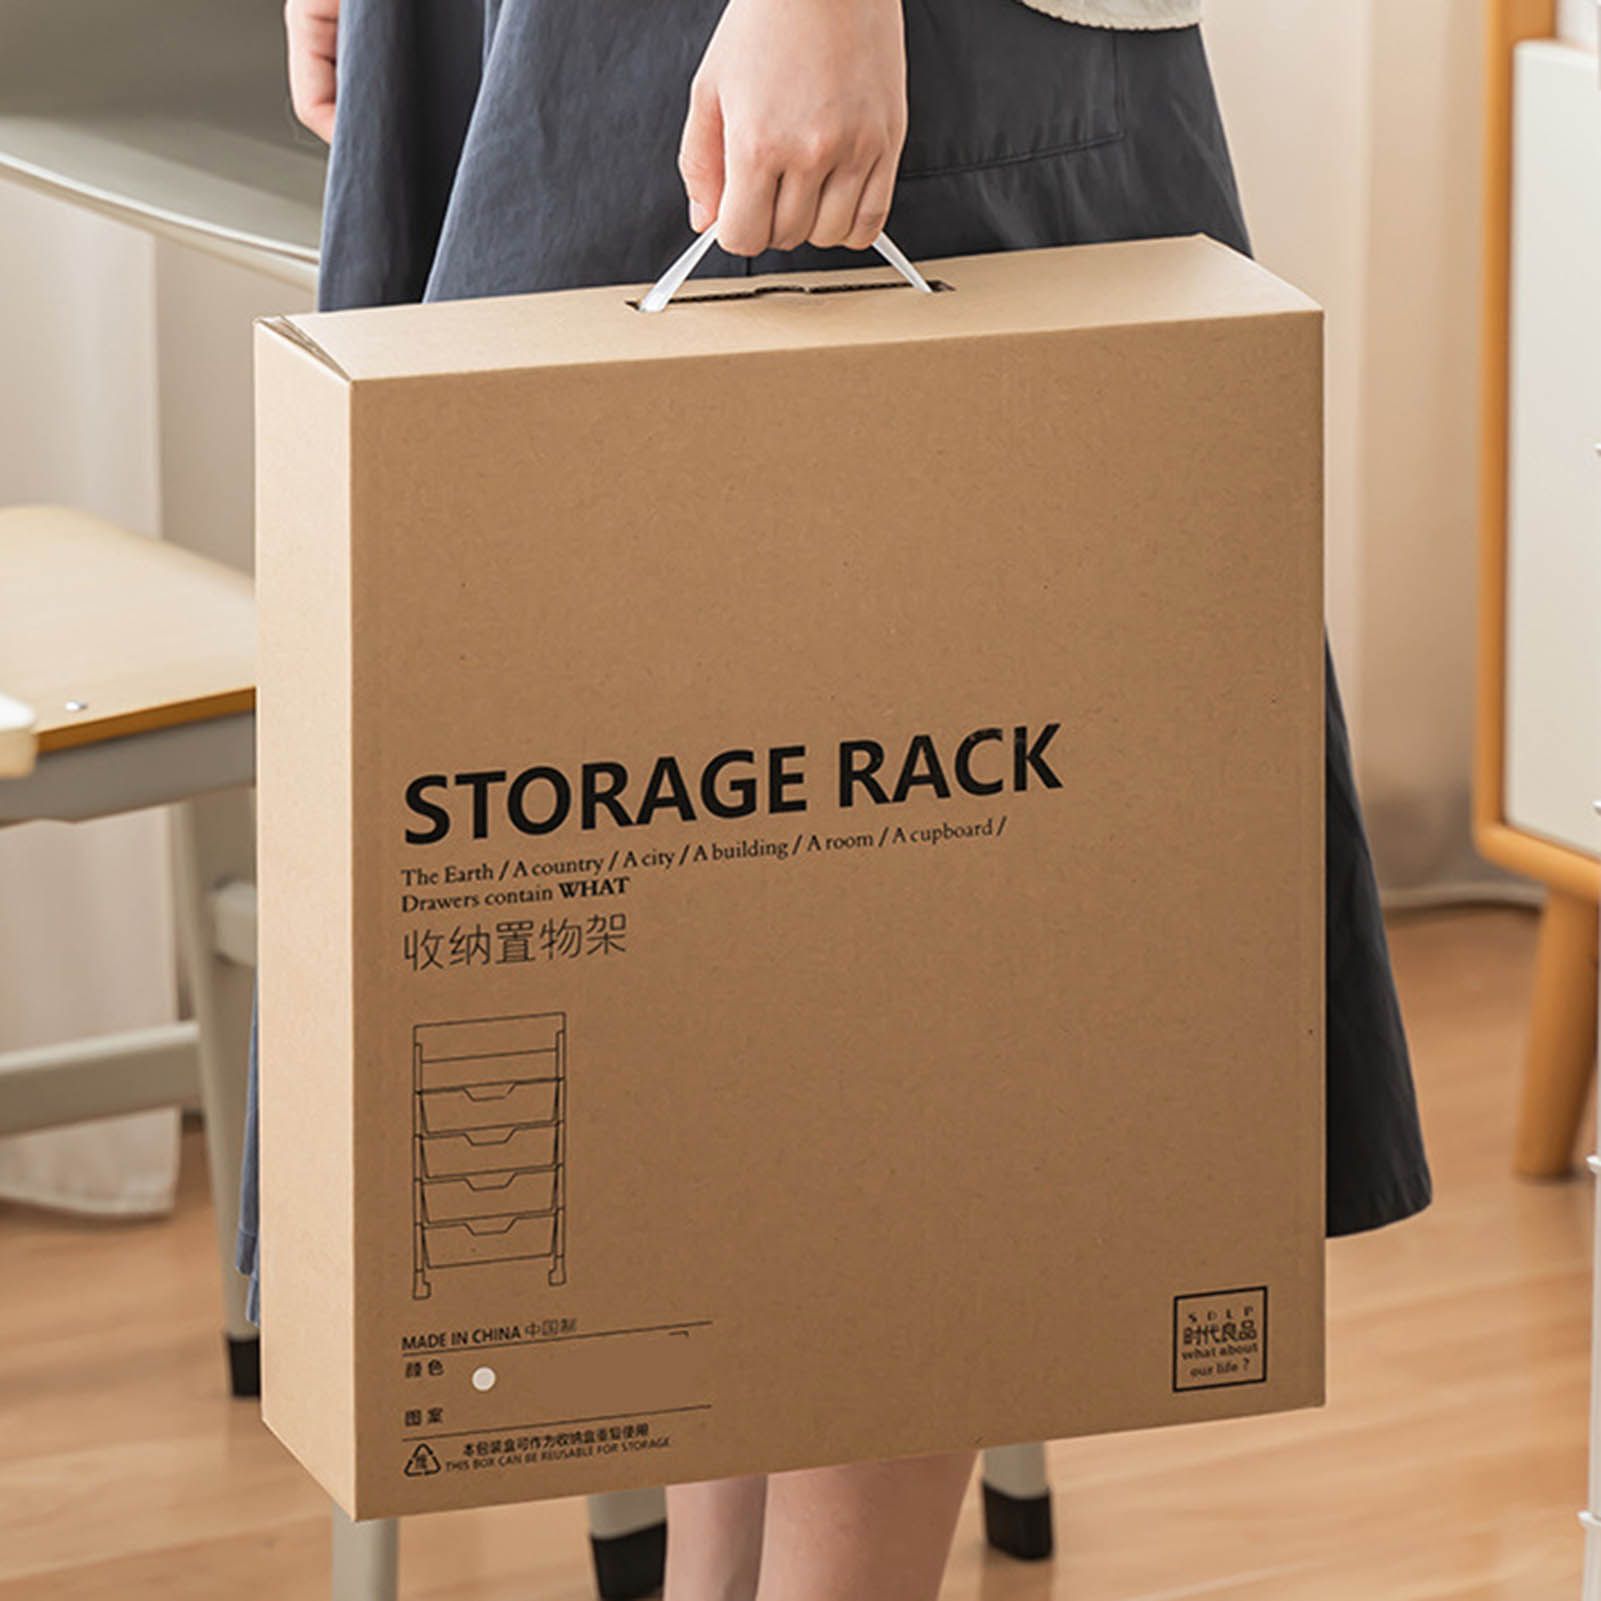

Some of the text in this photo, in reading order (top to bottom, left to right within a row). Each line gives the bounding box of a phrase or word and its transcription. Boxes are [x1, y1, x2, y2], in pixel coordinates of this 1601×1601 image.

[404, 722, 1064, 845] STORAGE RACK
[401, 816, 1008, 887] The Earth / A country / A city / A building / A room / A cupboard /
[401, 876, 631, 913] Drawers contain WHAT
[403, 913, 627, 971] 收纳置物架
[401, 1333, 447, 1351] MADE
[451, 1331, 468, 1346] IN
[471, 1325, 522, 1344] CHINA
[1182, 1342, 1259, 1361] what about
[446, 1460, 470, 1472] THIS
[498, 1455, 522, 1467] CAN
